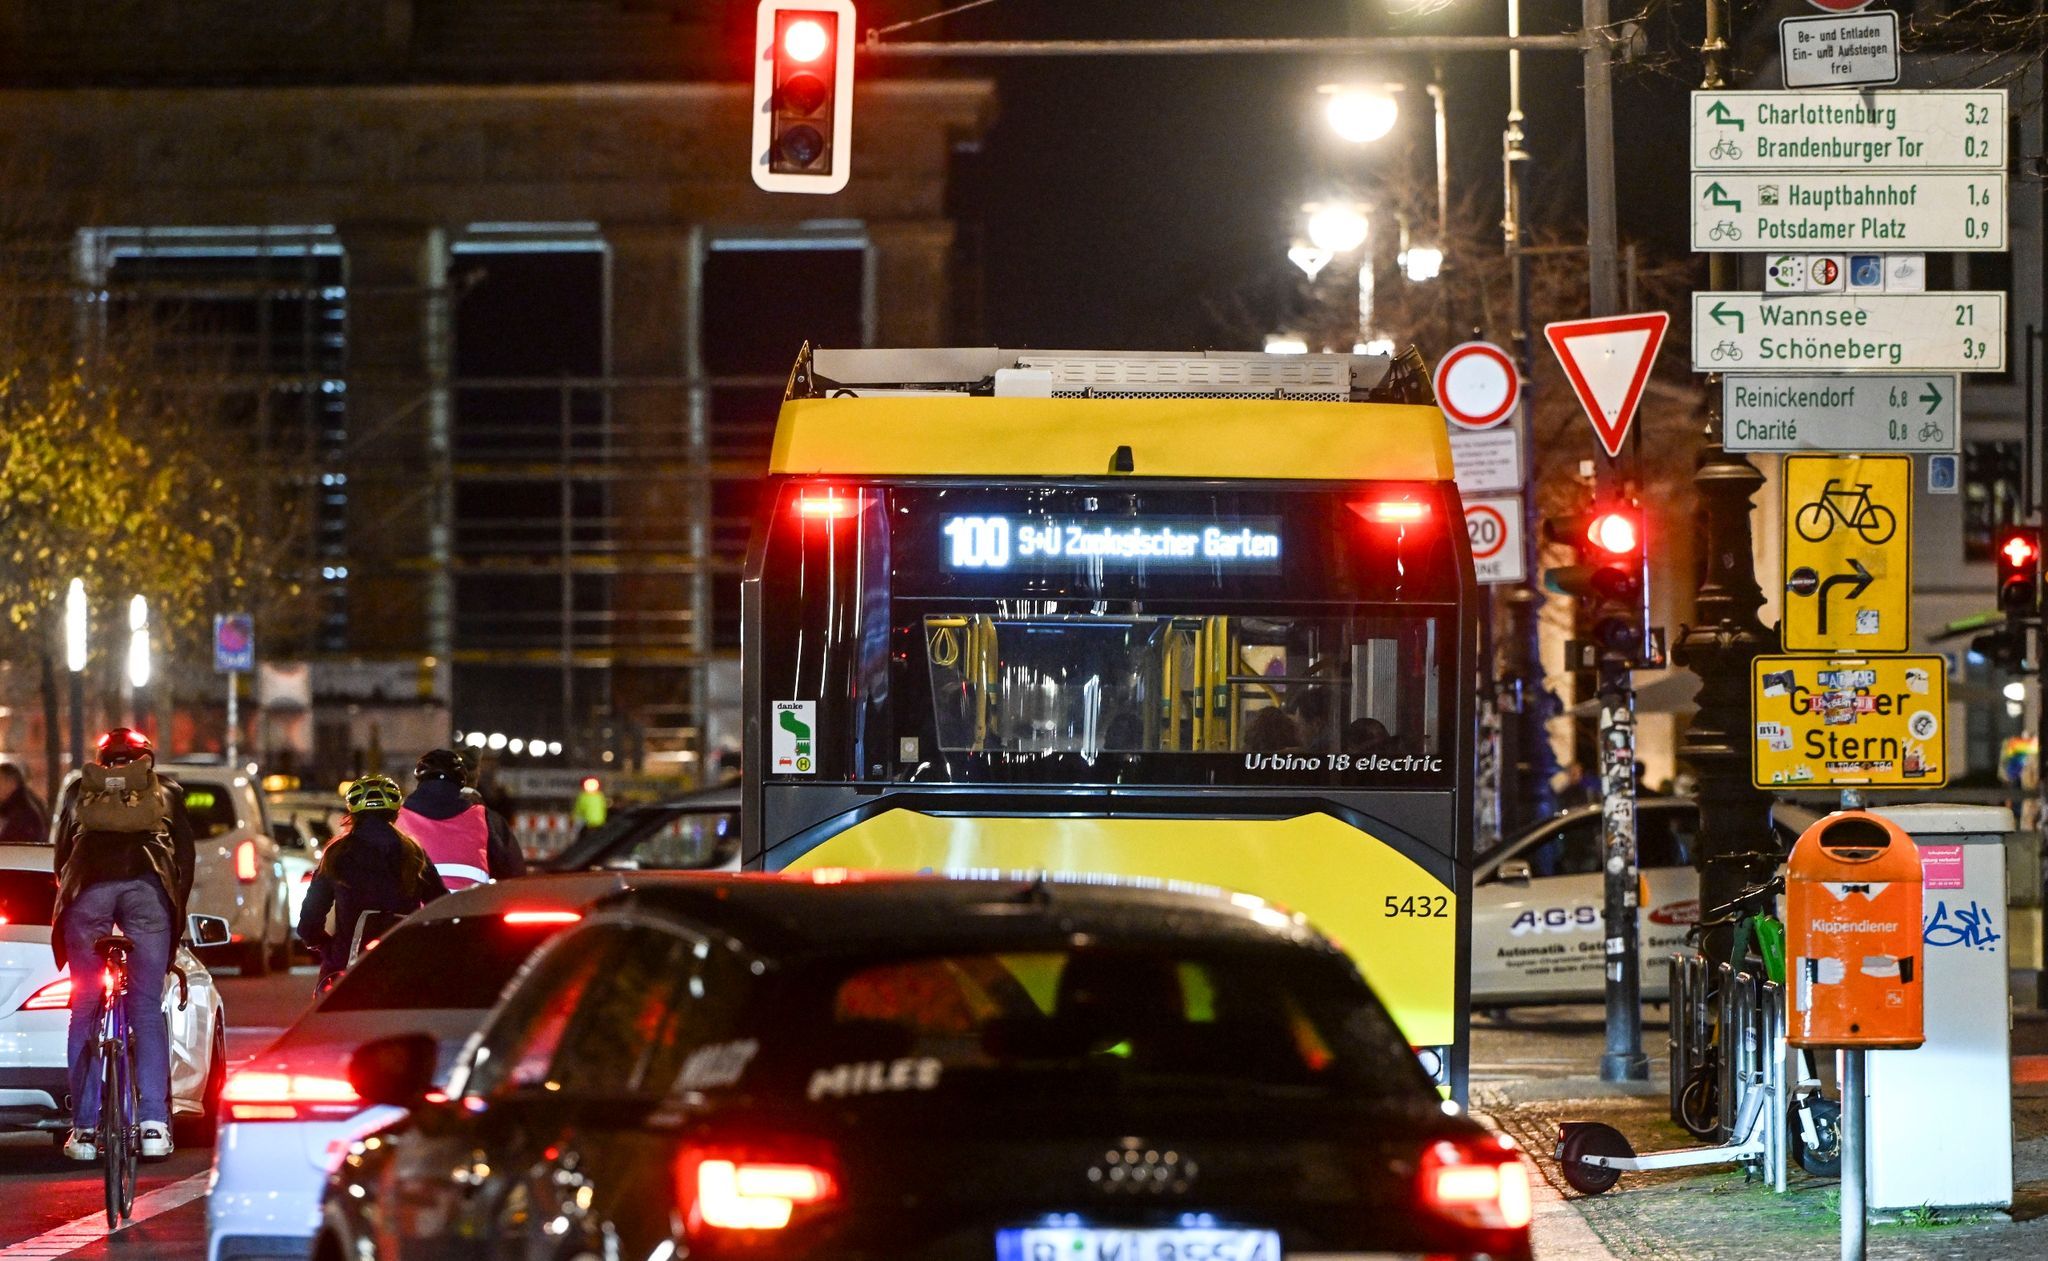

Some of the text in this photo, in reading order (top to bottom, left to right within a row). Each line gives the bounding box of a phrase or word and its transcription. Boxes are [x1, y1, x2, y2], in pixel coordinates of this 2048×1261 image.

[1798, 26, 1880, 43] Be- und Entladen
[1792, 43, 1887, 60] Ein- und Aussteigen
[1831, 61, 1852, 74] frei
[1757, 103, 1989, 129] Charlottenburg 3,2
[1757, 137, 1989, 163] Brandenburger Tor 0,2
[1789, 184, 1990, 210] Hauptbahnhof 1,6
[1757, 217, 1989, 240] Potsdamer Platz 0,9
[1781, 267, 1794, 277] R1
[1828, 266, 1836, 277] 3
[1759, 304, 1974, 326] Wannsee 21
[1759, 338, 1986, 364] Schöneberg 3,9
[1735, 387, 1908, 408] Reinickendorf 6,8
[1735, 419, 1908, 441] Charité 0,8
[945, 516, 1278, 567] 100 S+U Zoologischer Garten
[1468, 520, 1496, 545] 20
[1805, 729, 1898, 760] Stern
[1245, 753, 1442, 772] Urbino 18 electric
[1384, 896, 1448, 918] 5432
[1811, 919, 1898, 934] Kippendiener
[806, 1057, 942, 1101] MILES
